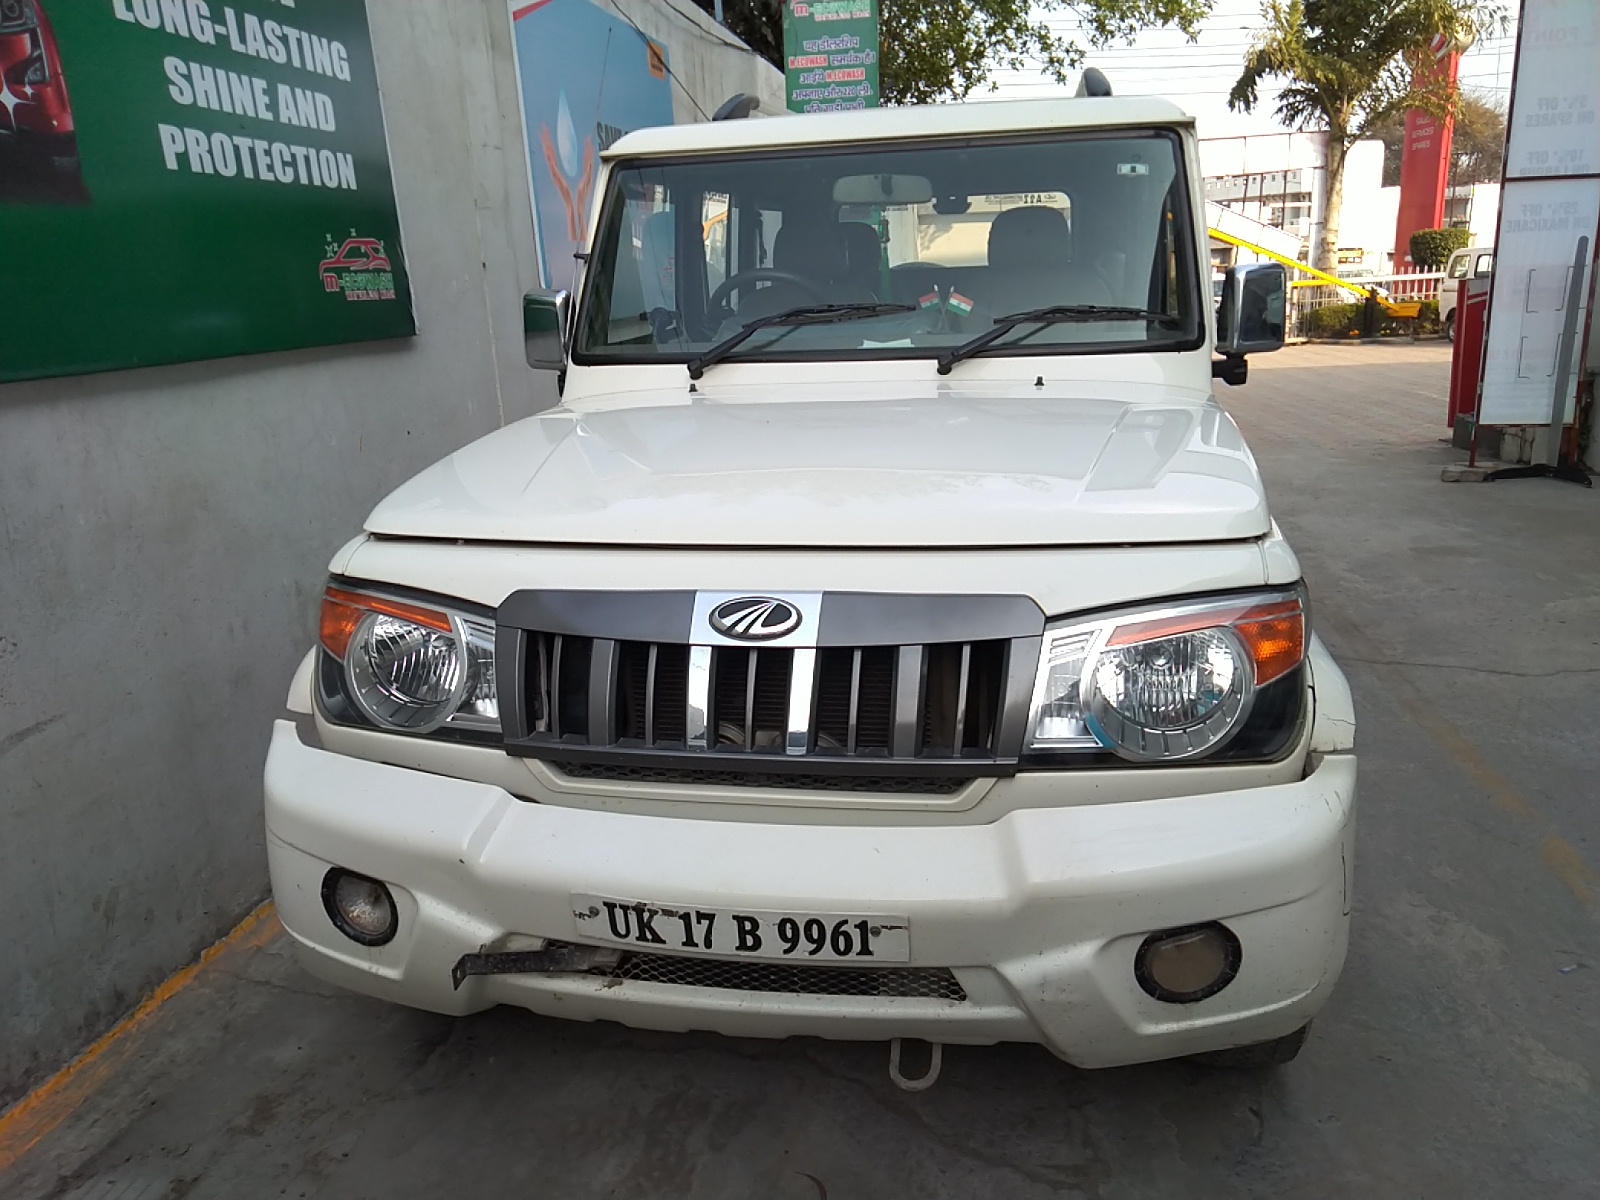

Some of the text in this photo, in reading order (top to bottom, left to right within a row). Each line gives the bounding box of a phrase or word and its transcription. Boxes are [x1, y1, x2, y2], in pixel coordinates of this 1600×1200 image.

[163, 56, 336, 132] SHINE AND
[158, 124, 357, 190] PROTECTION
[602, 901, 875, 956] UK 17 B 9961
